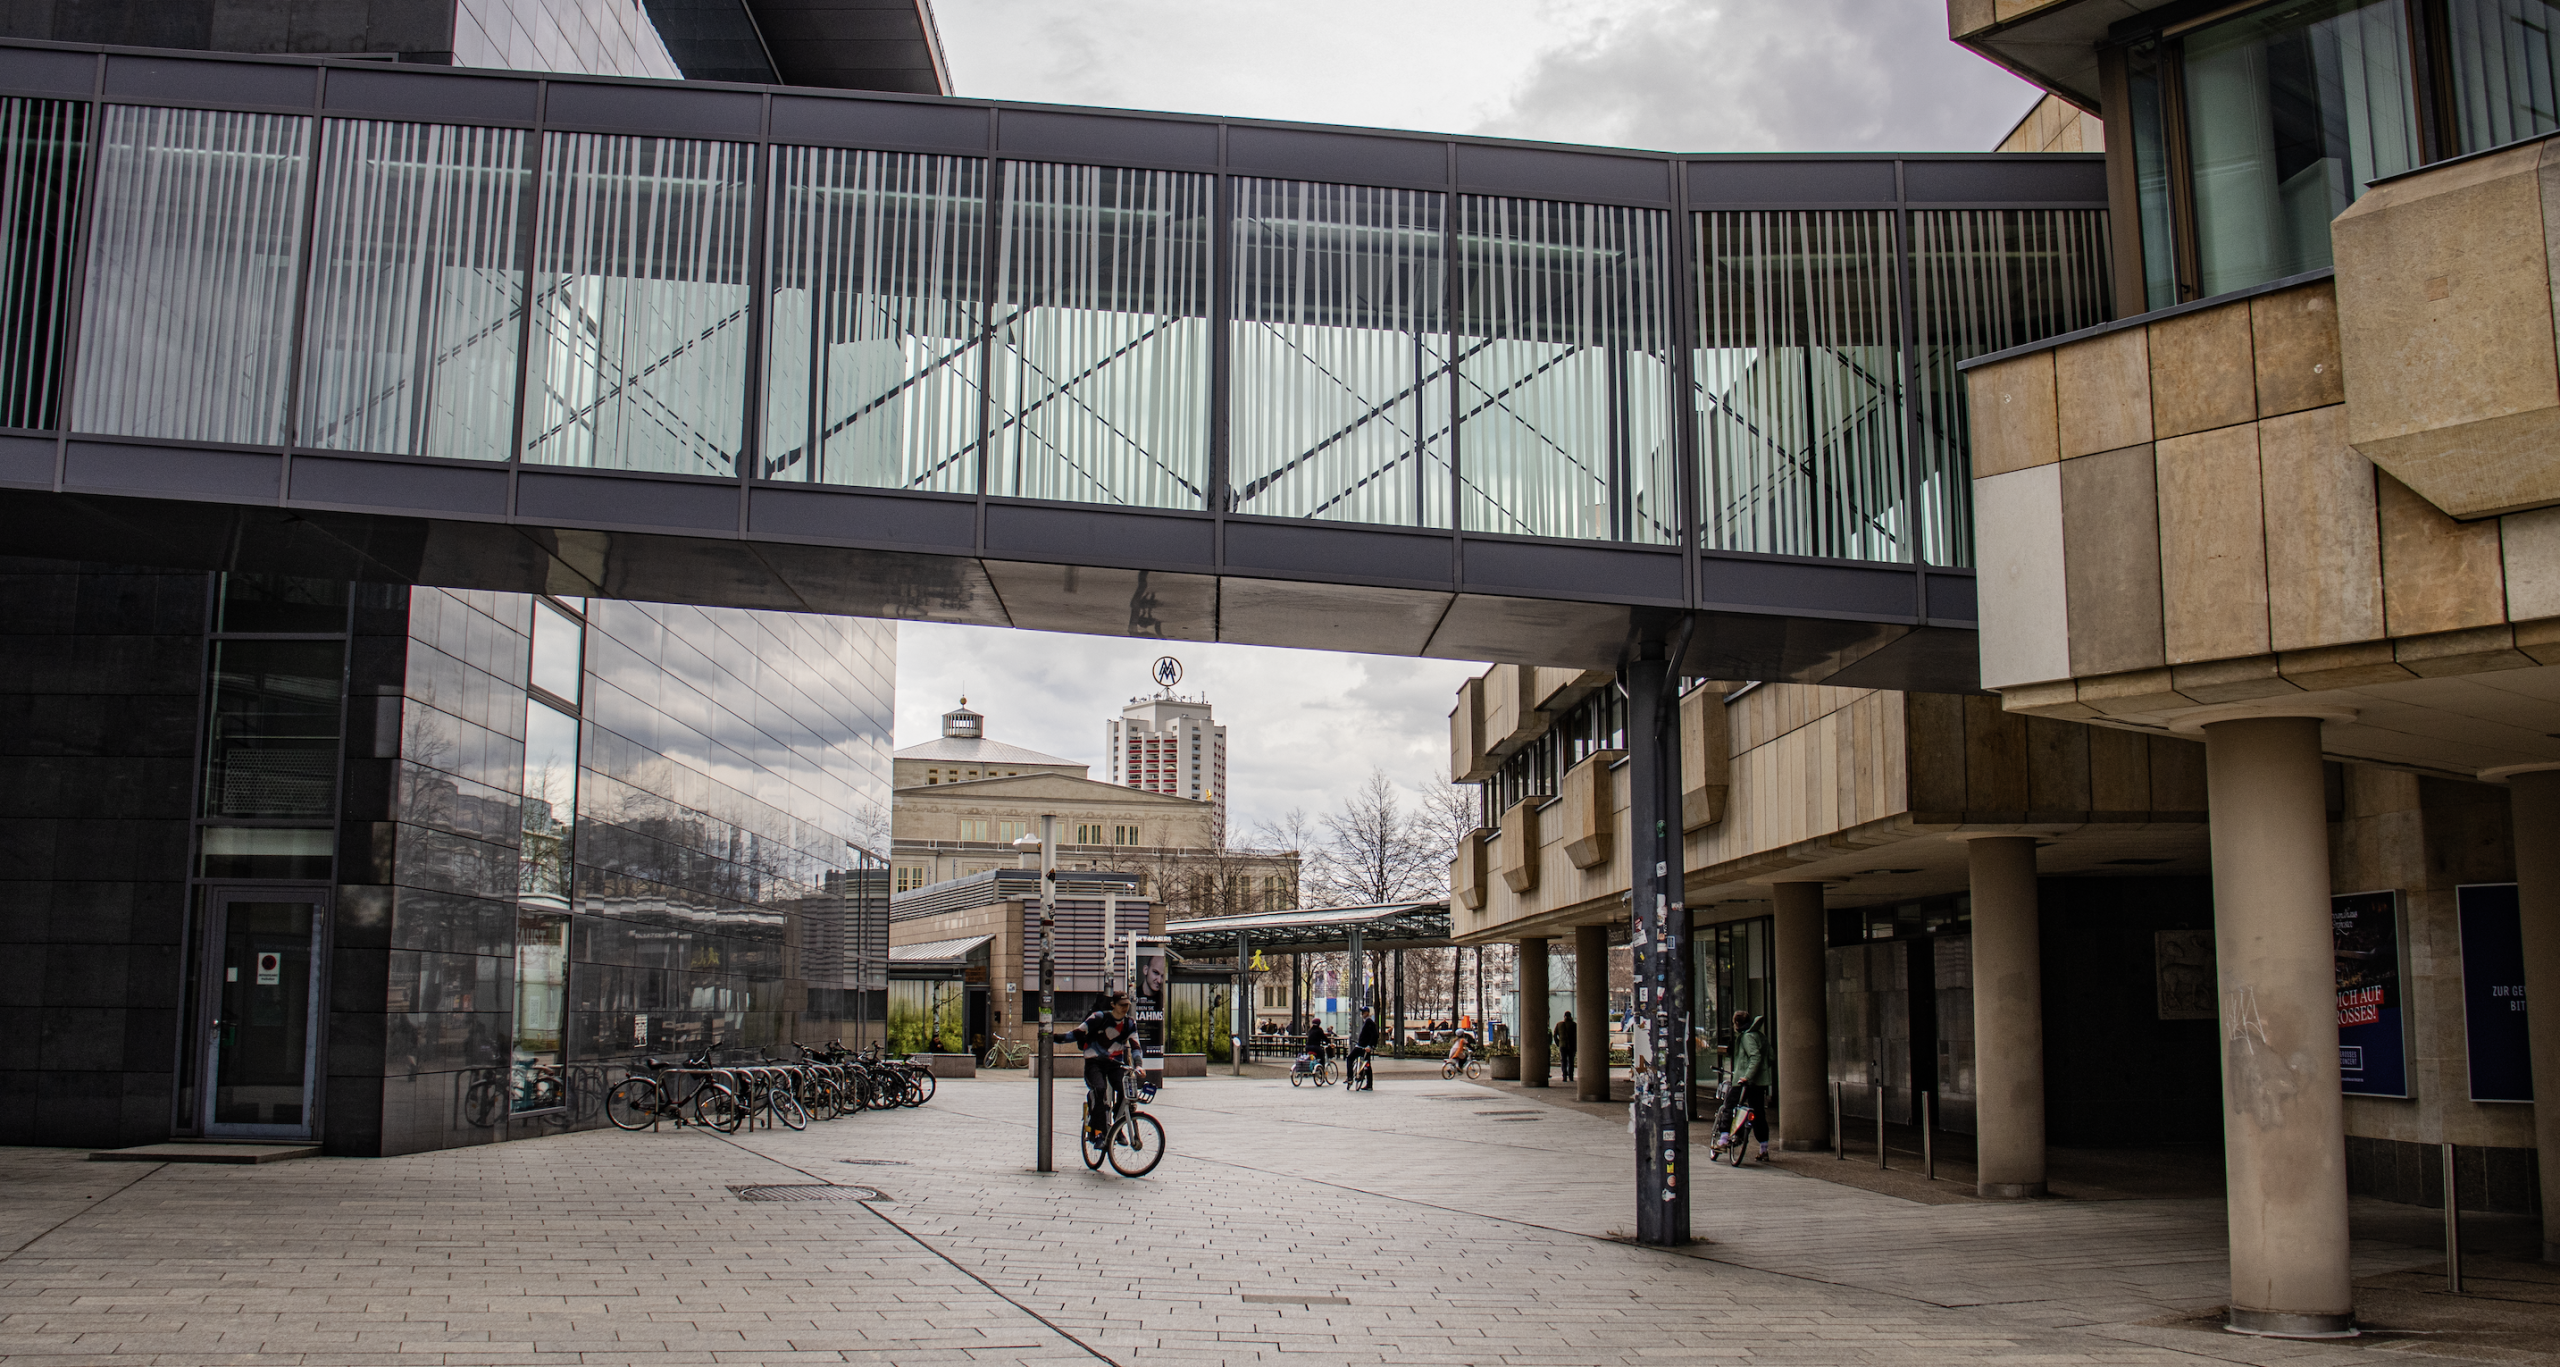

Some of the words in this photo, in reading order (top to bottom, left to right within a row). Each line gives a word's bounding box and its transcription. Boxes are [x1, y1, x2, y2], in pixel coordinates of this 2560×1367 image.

[2360, 985, 2382, 1003] AUF
[2492, 985, 2510, 997] ZUR
[2512, 985, 2526, 997] GE
